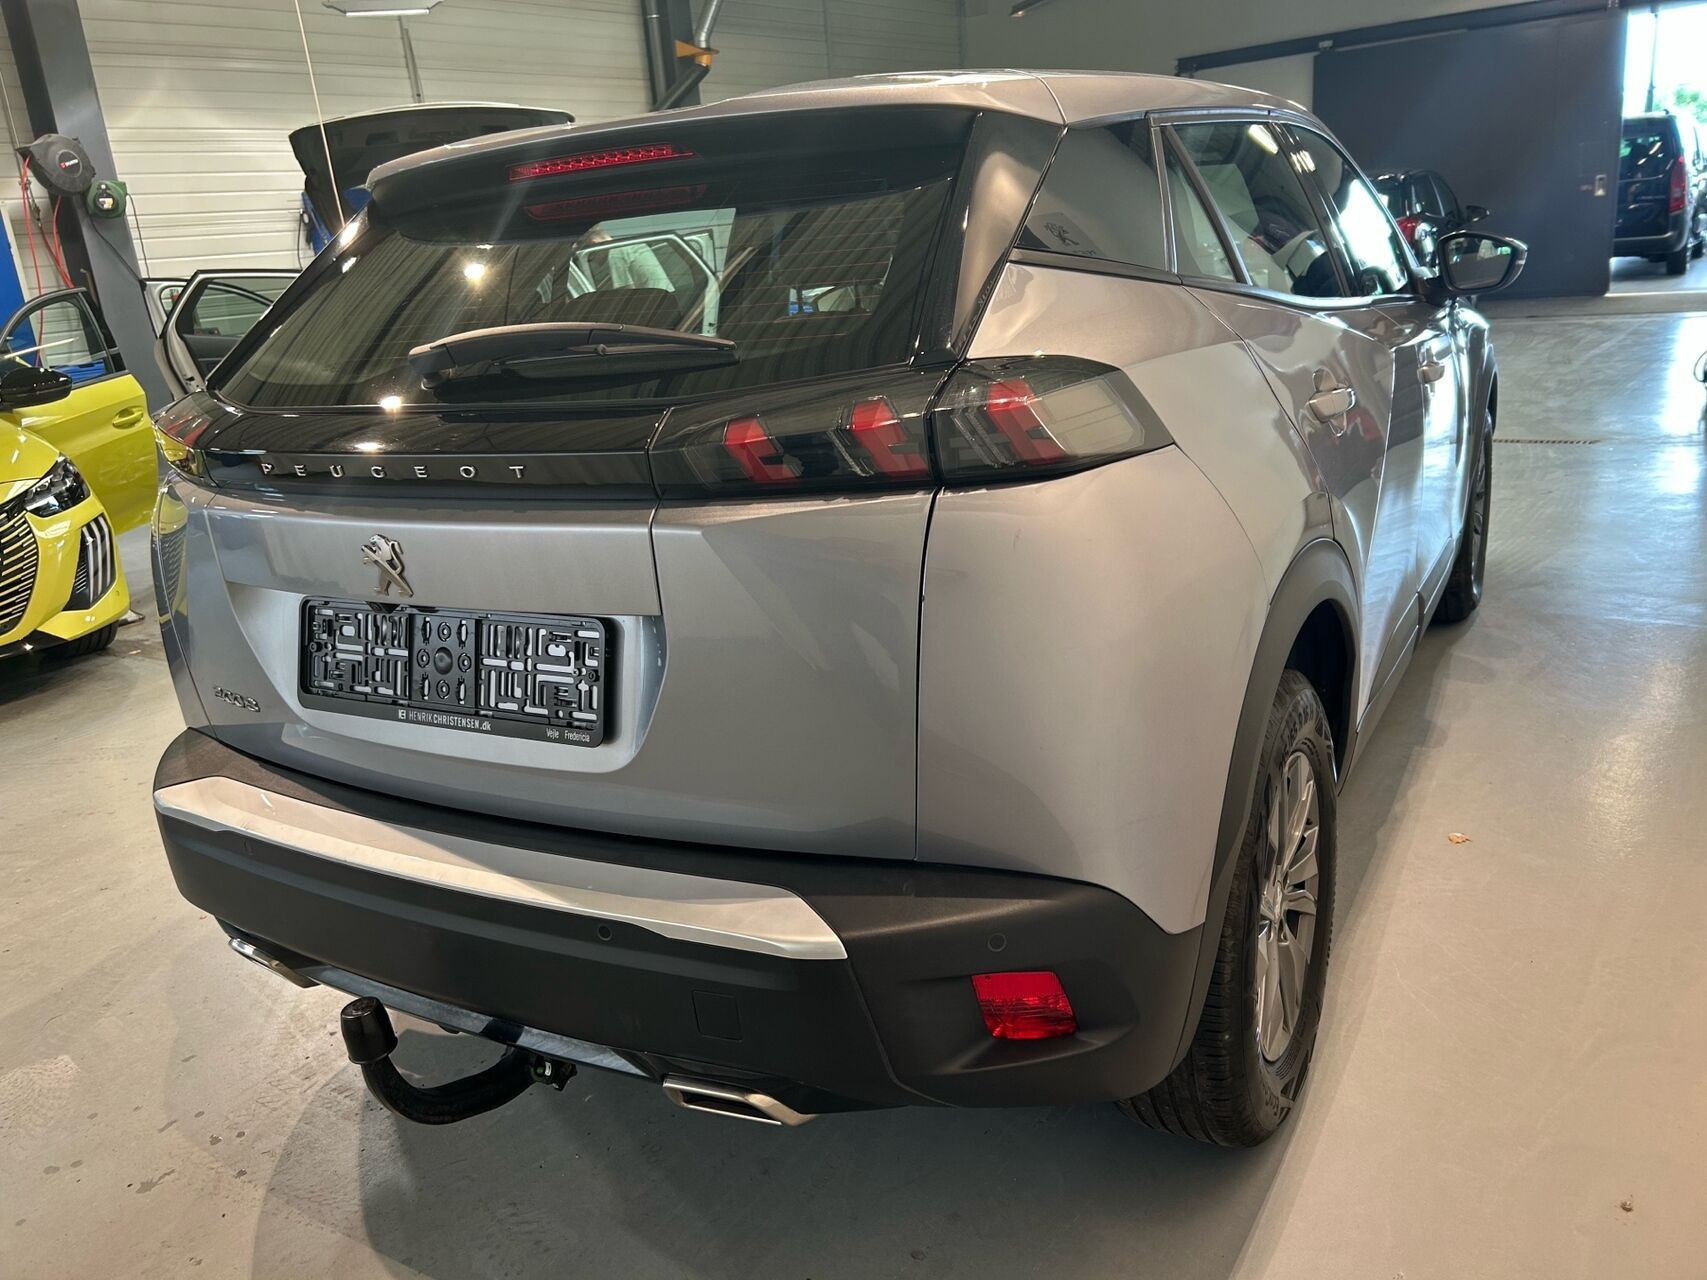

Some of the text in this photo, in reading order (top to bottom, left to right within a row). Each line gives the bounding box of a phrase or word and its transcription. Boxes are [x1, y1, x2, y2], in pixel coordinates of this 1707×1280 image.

[260, 463, 524, 478] PEUGEOT
[545, 727, 591, 743] Vejle Fredericia
